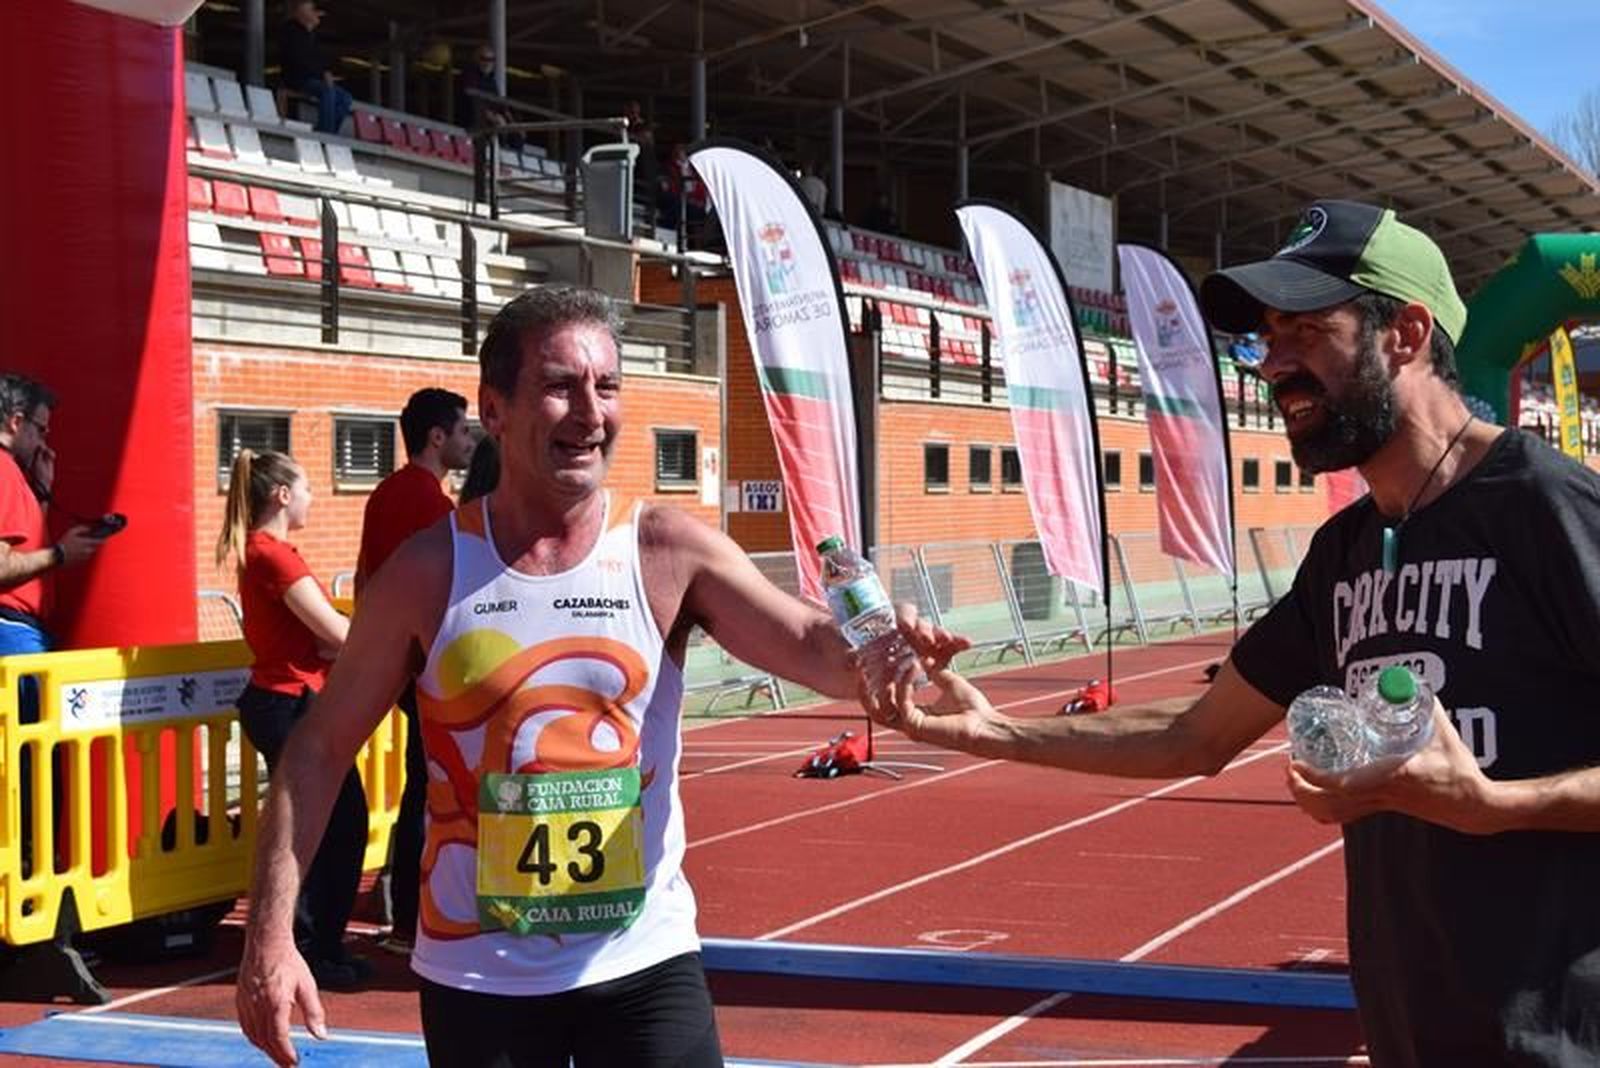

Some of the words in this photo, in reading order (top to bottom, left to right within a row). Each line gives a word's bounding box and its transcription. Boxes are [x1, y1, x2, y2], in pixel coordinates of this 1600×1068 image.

[745, 483, 780, 493] ASEOS
[473, 600, 518, 615] GUMER
[553, 598, 630, 610] CAZABACHES
[1395, 558, 1497, 650] CITY
[527, 796, 566, 811] CAJA
[570, 792, 622, 808] RURAL
[516, 820, 606, 886] 43
[578, 901, 639, 921] RURAL
